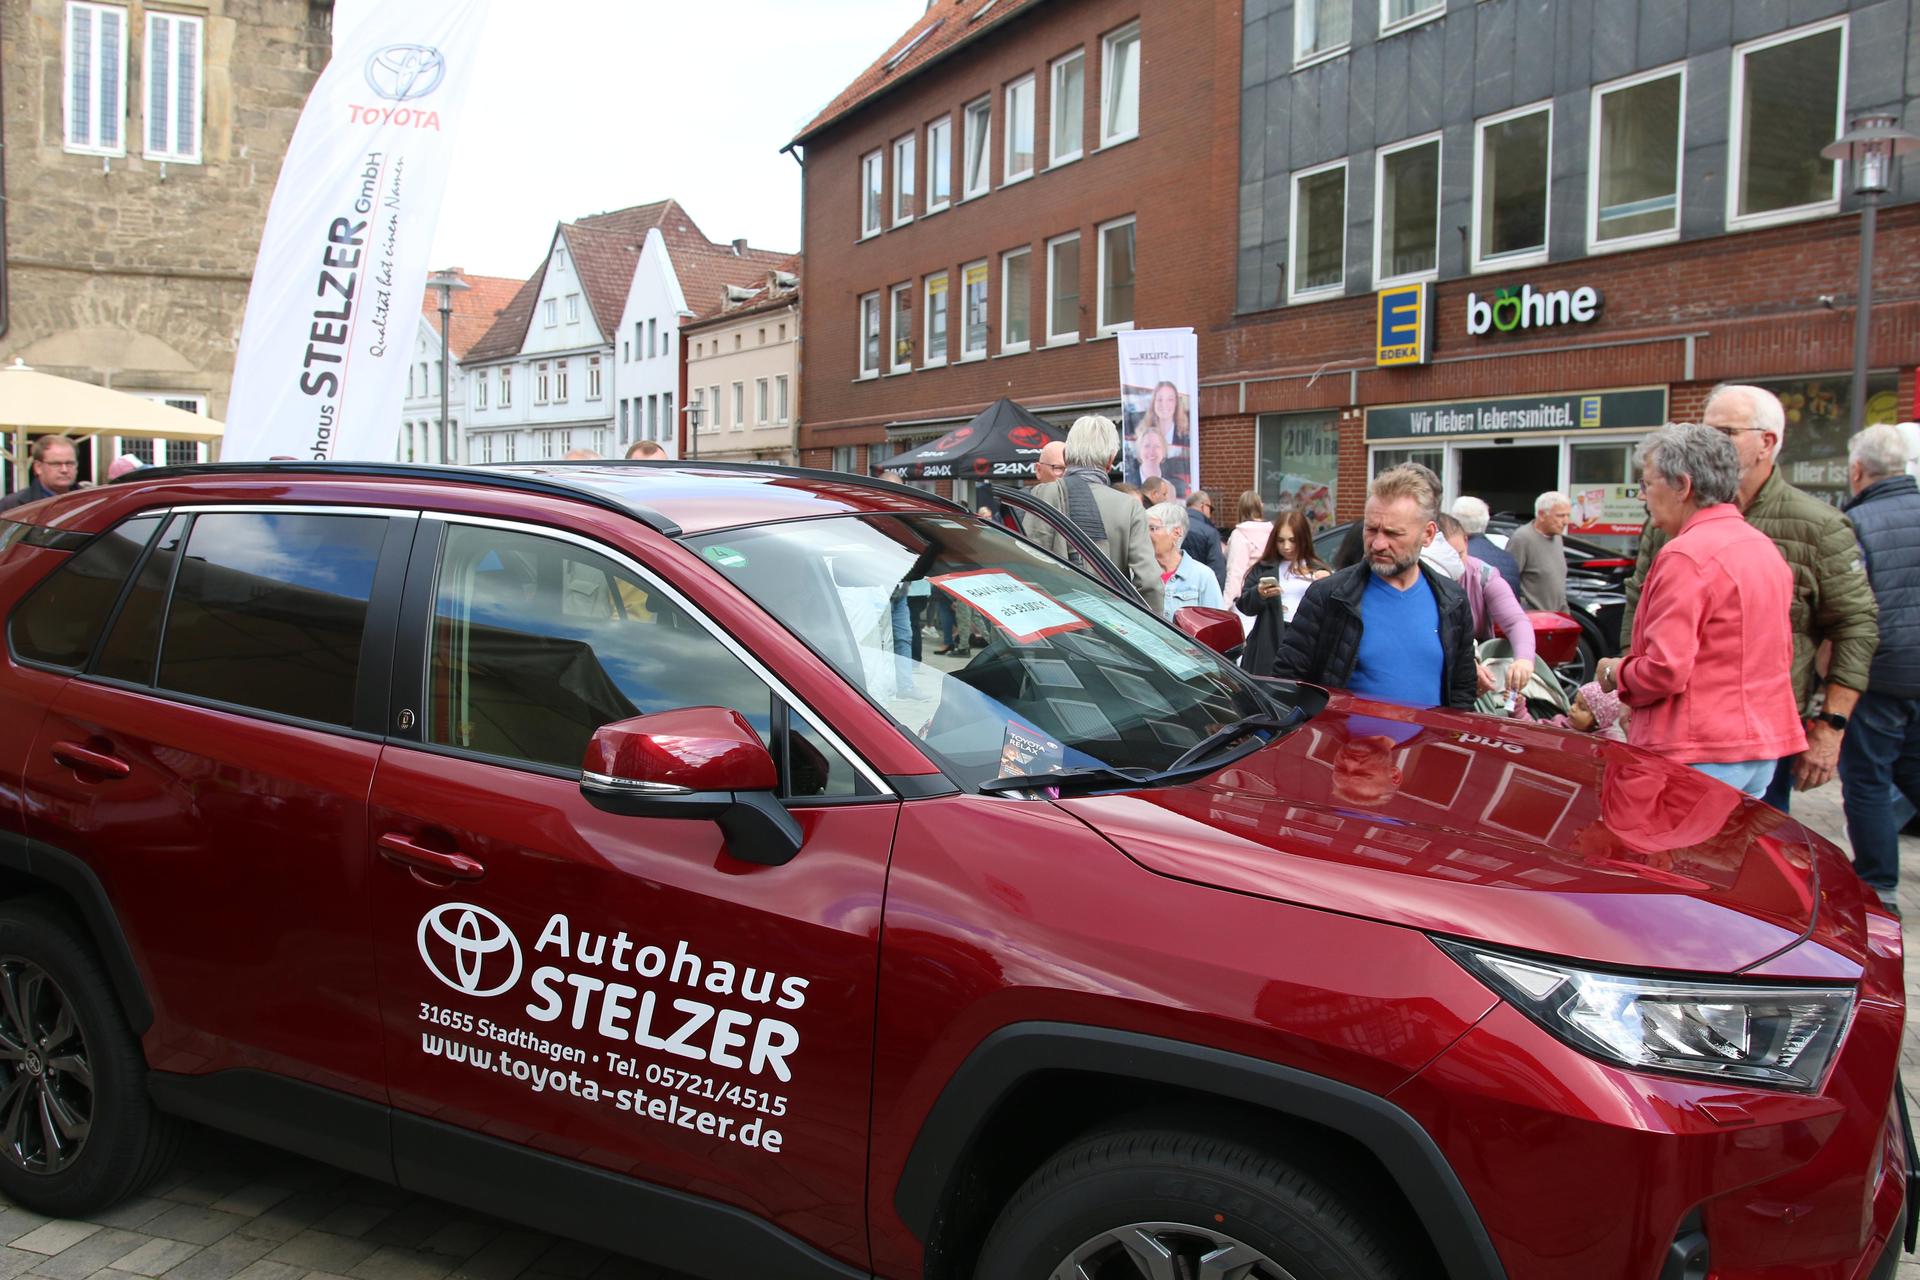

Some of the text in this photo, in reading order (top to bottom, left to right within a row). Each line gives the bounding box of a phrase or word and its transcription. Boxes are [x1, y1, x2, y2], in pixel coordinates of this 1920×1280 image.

[348, 104, 440, 132] TOYOTA
[369, 156, 404, 358] Qualität hat einen Namen
[300, 216, 367, 398] STELZER
[355, 152, 382, 214] GmbH
[1380, 347, 1417, 361] EDEKA
[1410, 402, 1574, 434] Wir lieben Lebensmittel.
[1284, 429, 1321, 457] 20%
[923, 465, 952, 476] 24MX
[992, 462, 1036, 474] 24M
[1793, 461, 1848, 483] Hier iss
[1009, 738, 1038, 756] RELAX
[1011, 732, 1046, 753] TOYOTA
[534, 913, 811, 1010] Autohaus
[525, 965, 800, 1083] STELZER
[418, 1002, 788, 1118] 31655 Stadthagen Tel. 05721/4515
[421, 1032, 784, 1154] www.toyota-stelzer.de
